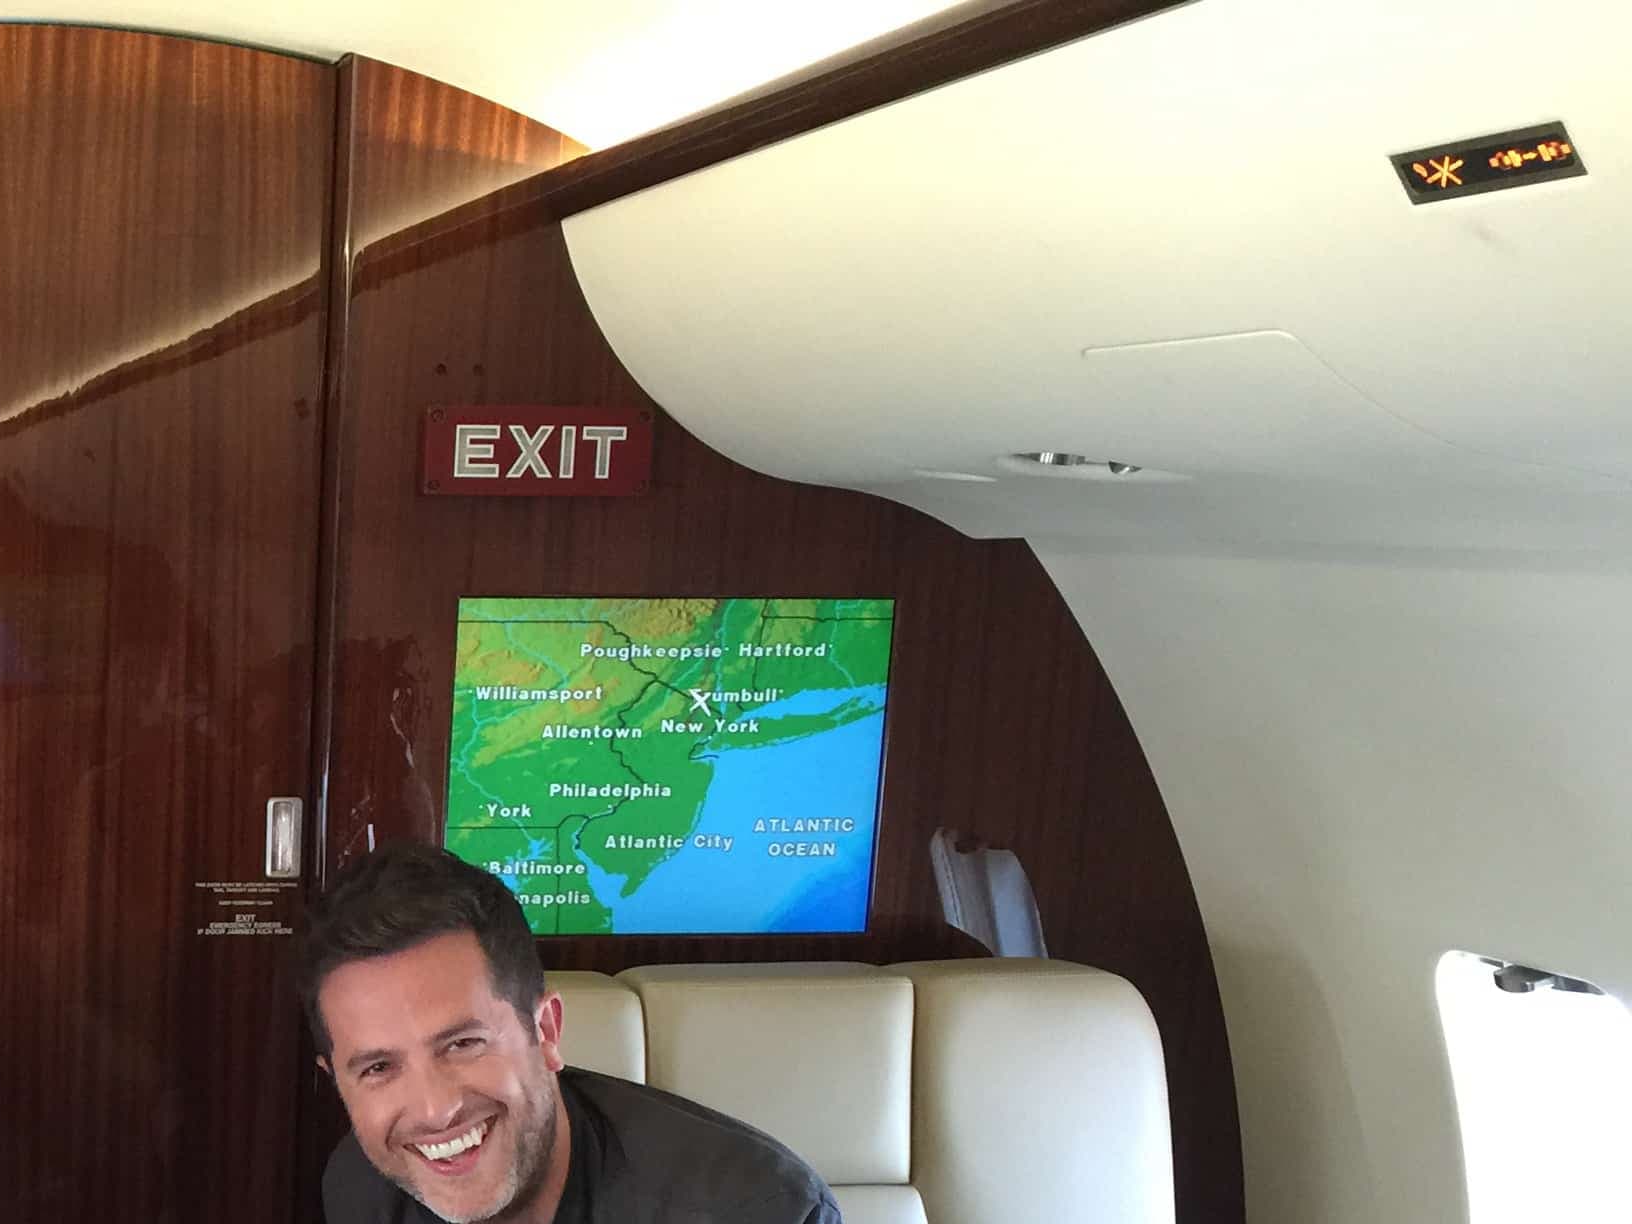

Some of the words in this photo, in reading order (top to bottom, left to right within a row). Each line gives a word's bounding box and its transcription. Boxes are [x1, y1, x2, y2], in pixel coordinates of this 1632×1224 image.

[453, 424, 628, 479] EXIT
[580, 643, 722, 662] Poughkeepsie
[739, 643, 826, 658] Hartford
[475, 685, 603, 703] Williamsport
[689, 688, 778, 703] umbull
[542, 724, 643, 739] Allentown
[660, 719, 703, 733] New
[715, 719, 759, 733] York
[549, 783, 672, 801] Philadelphia
[486, 803, 532, 817] York
[754, 818, 855, 832] ATLANTIC
[604, 835, 685, 849] Atlantic
[694, 834, 734, 851] City
[768, 843, 836, 856] OCEAN
[488, 861, 585, 875] Baltimore
[515, 891, 590, 908] napolis
[235, 914, 257, 922] EXIT
